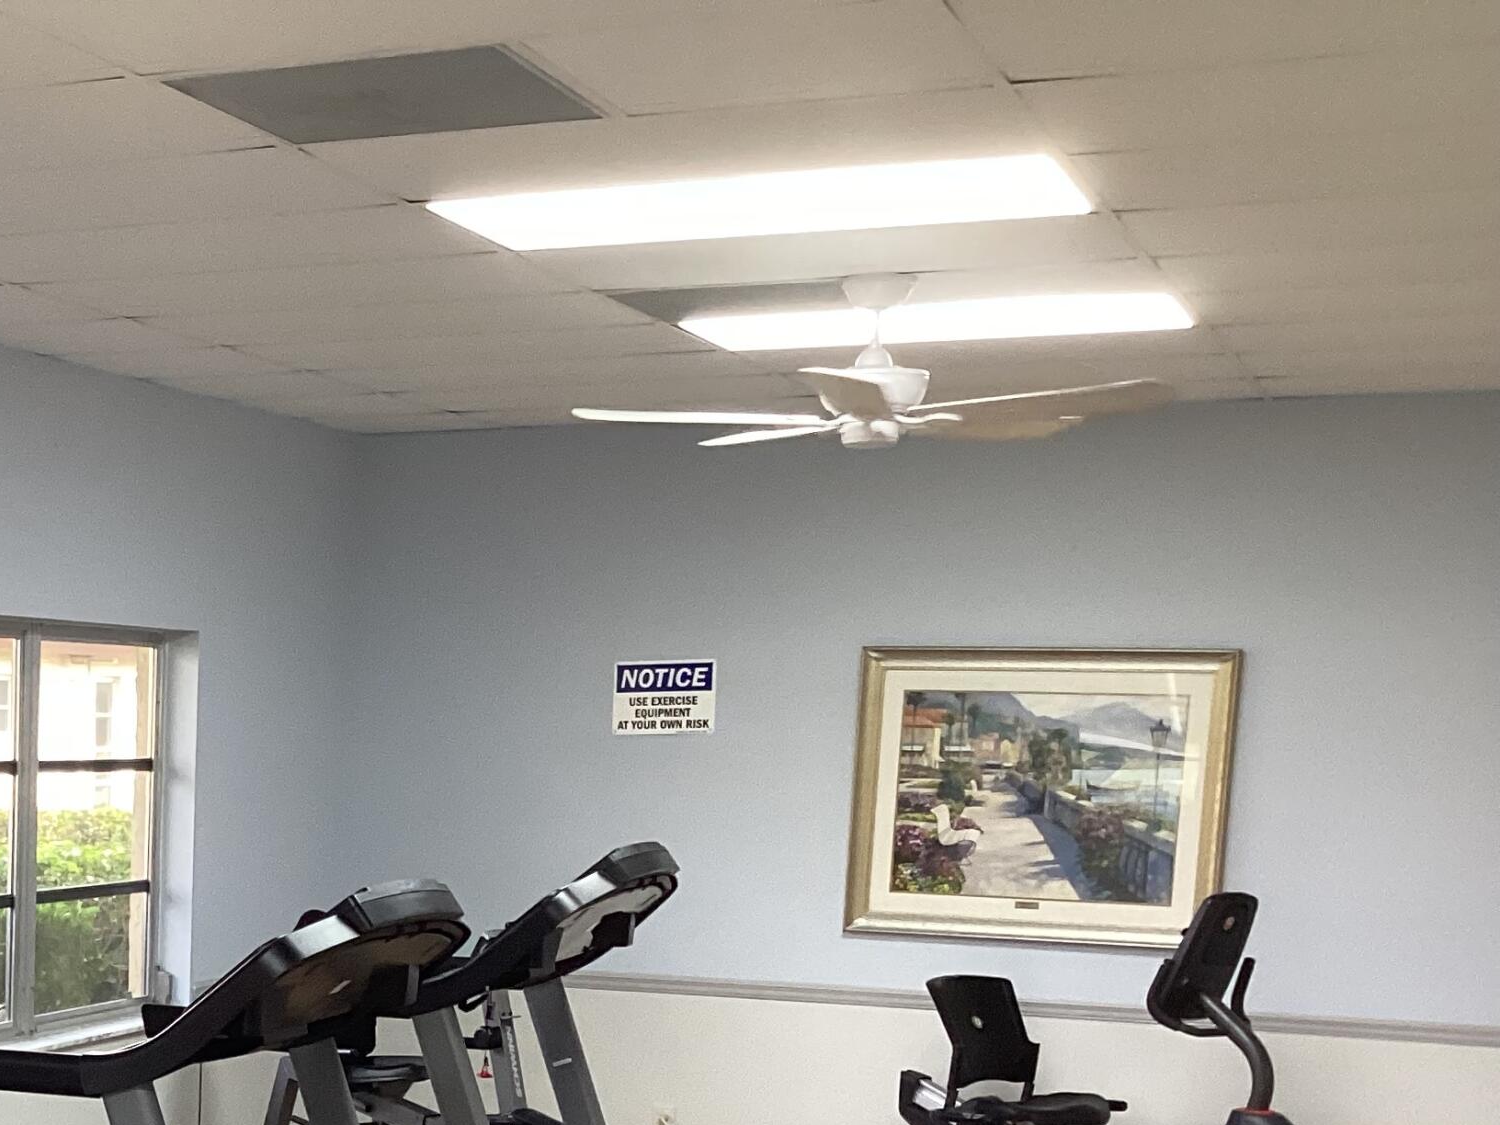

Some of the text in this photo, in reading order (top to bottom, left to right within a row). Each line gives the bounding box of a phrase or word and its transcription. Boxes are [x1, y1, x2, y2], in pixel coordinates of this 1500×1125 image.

[621, 667, 708, 688] NOTICE
[629, 696, 698, 706] USE EXERCISE
[635, 708, 691, 718] EQUIPMENT
[617, 719, 710, 730] AT YOUR OWN RISK
